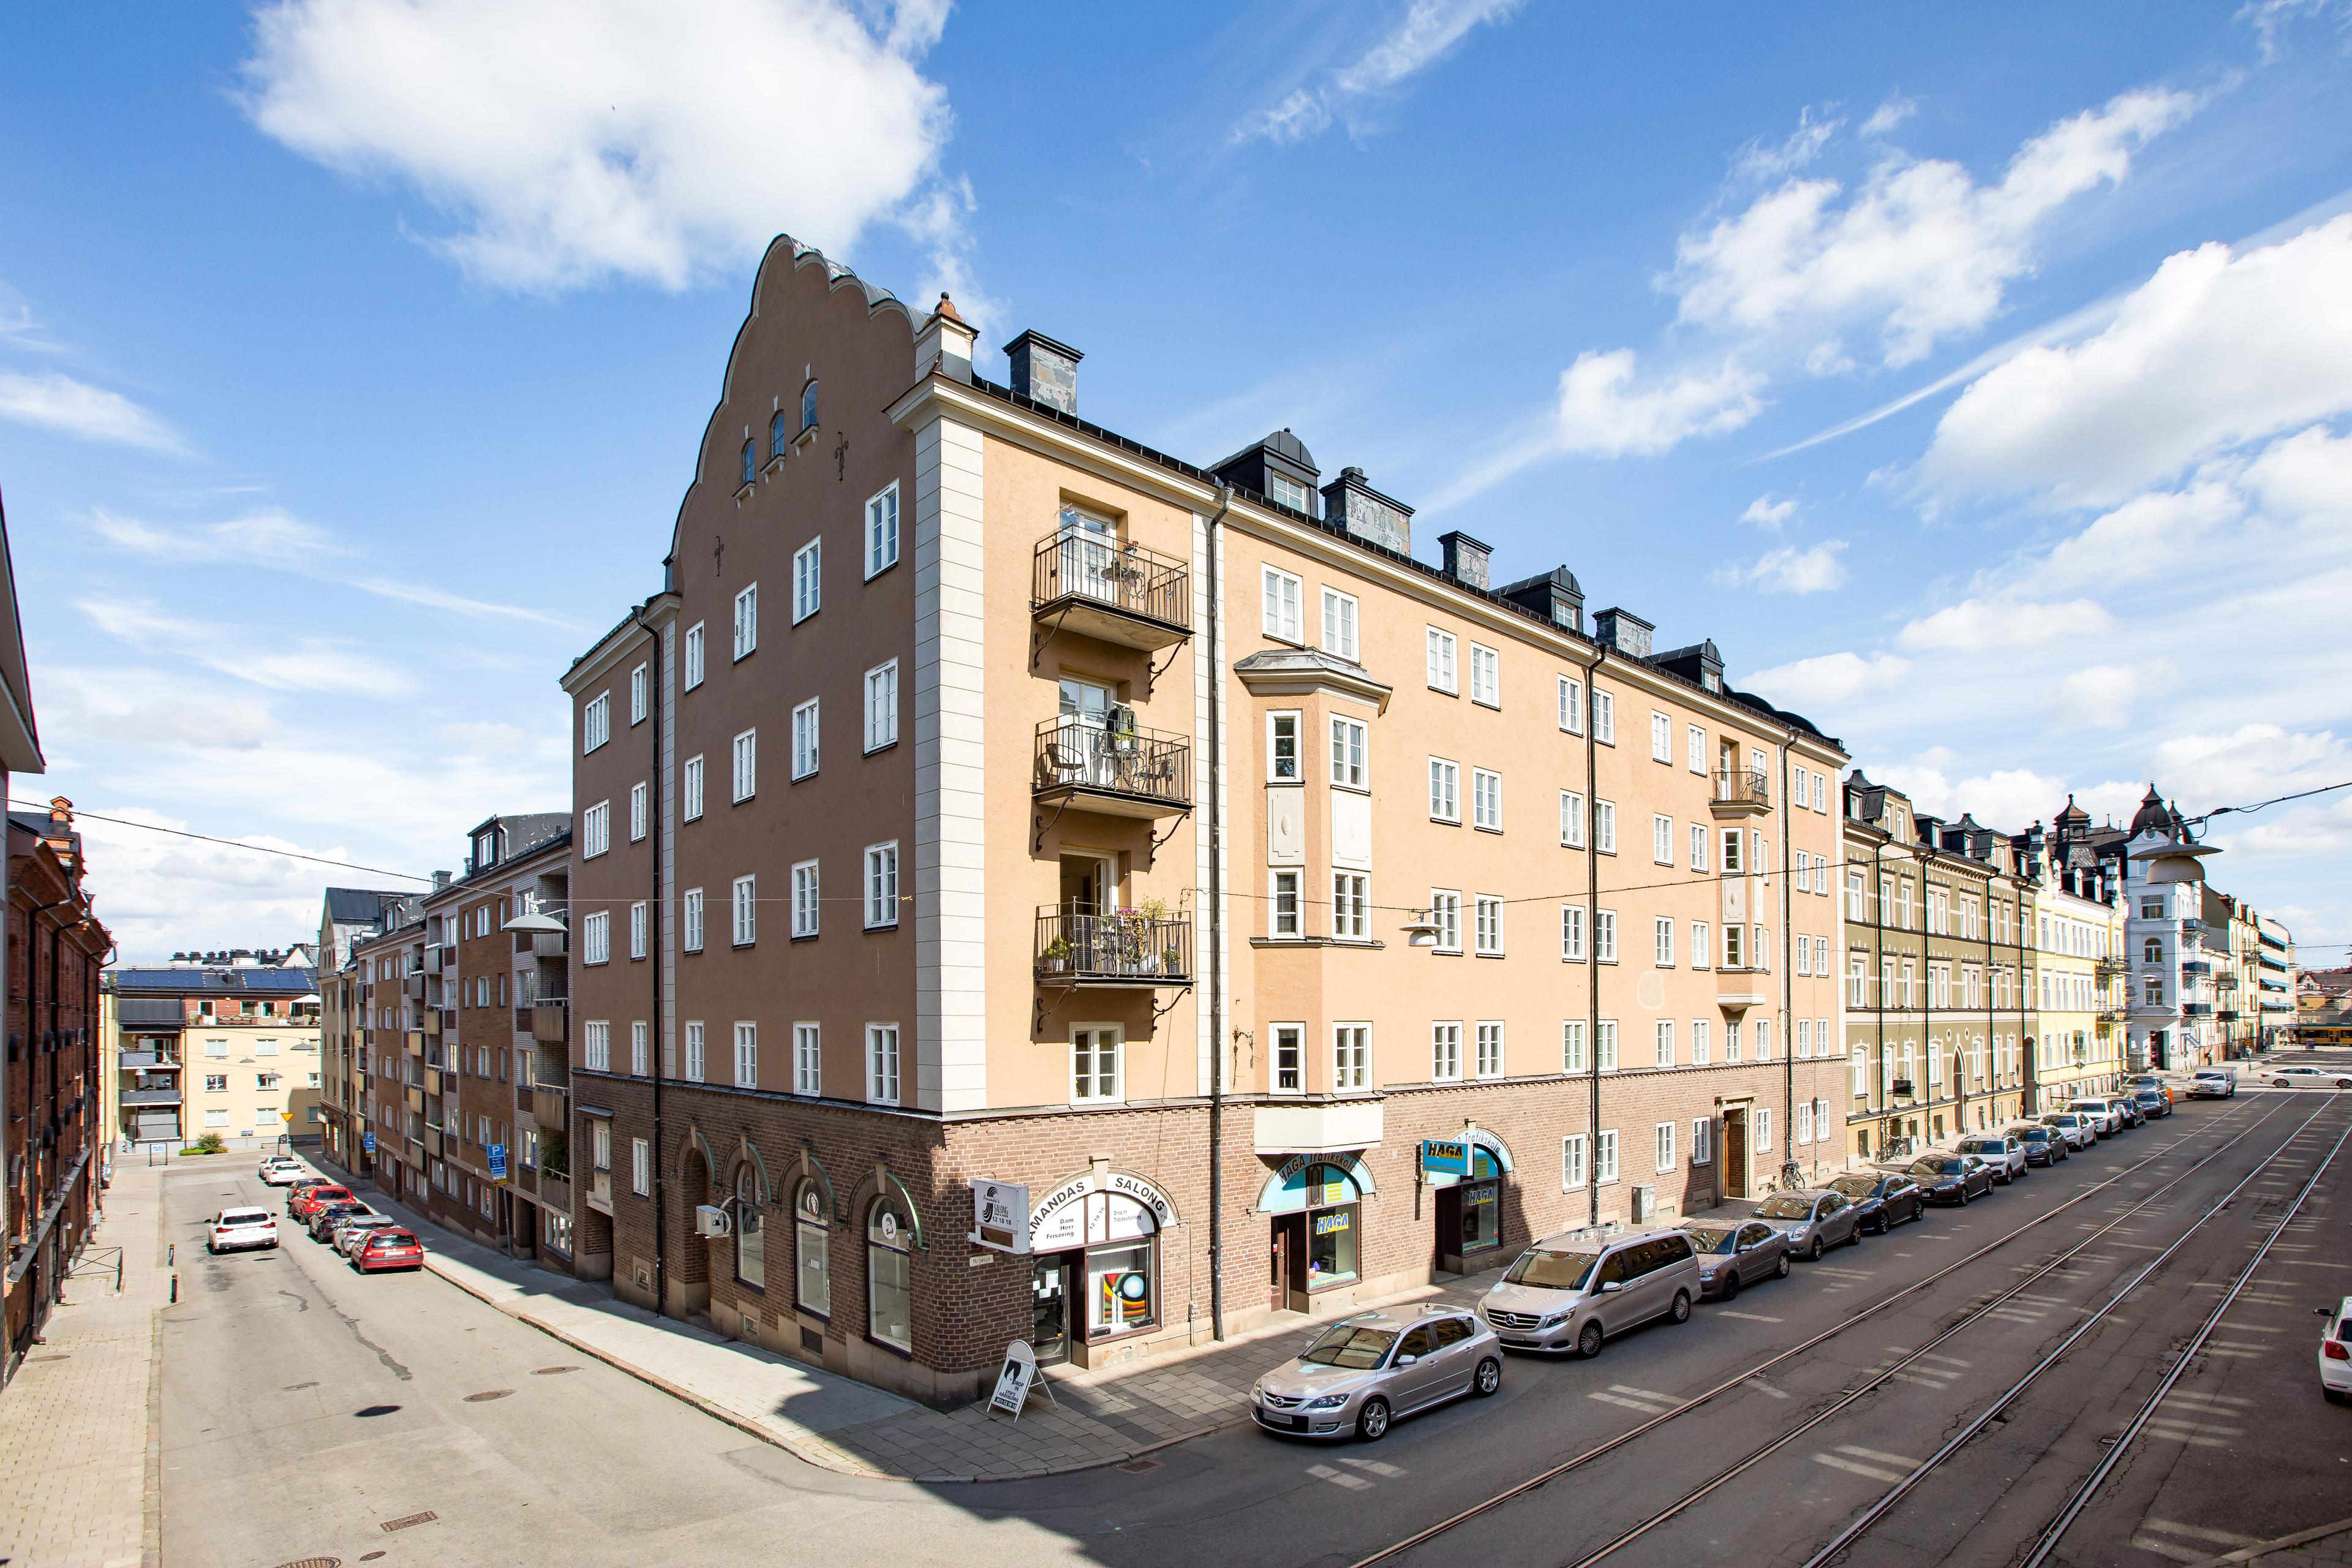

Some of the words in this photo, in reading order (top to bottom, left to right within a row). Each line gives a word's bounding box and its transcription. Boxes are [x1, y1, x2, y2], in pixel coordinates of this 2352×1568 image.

[492, 1146, 500, 1156] P
[1427, 1143, 1463, 1157] HAGA
[1465, 1131, 1500, 1153] Trafikskola
[1278, 1155, 1305, 1184] HAGA
[1469, 1188, 1493, 1205] HAGA
[994, 1204, 1009, 1215] SALONG
[1030, 1182, 1085, 1241] AMANDAS
[1115, 1178, 1164, 1211] SALONG
[1316, 1213, 1349, 1235] HAGA
